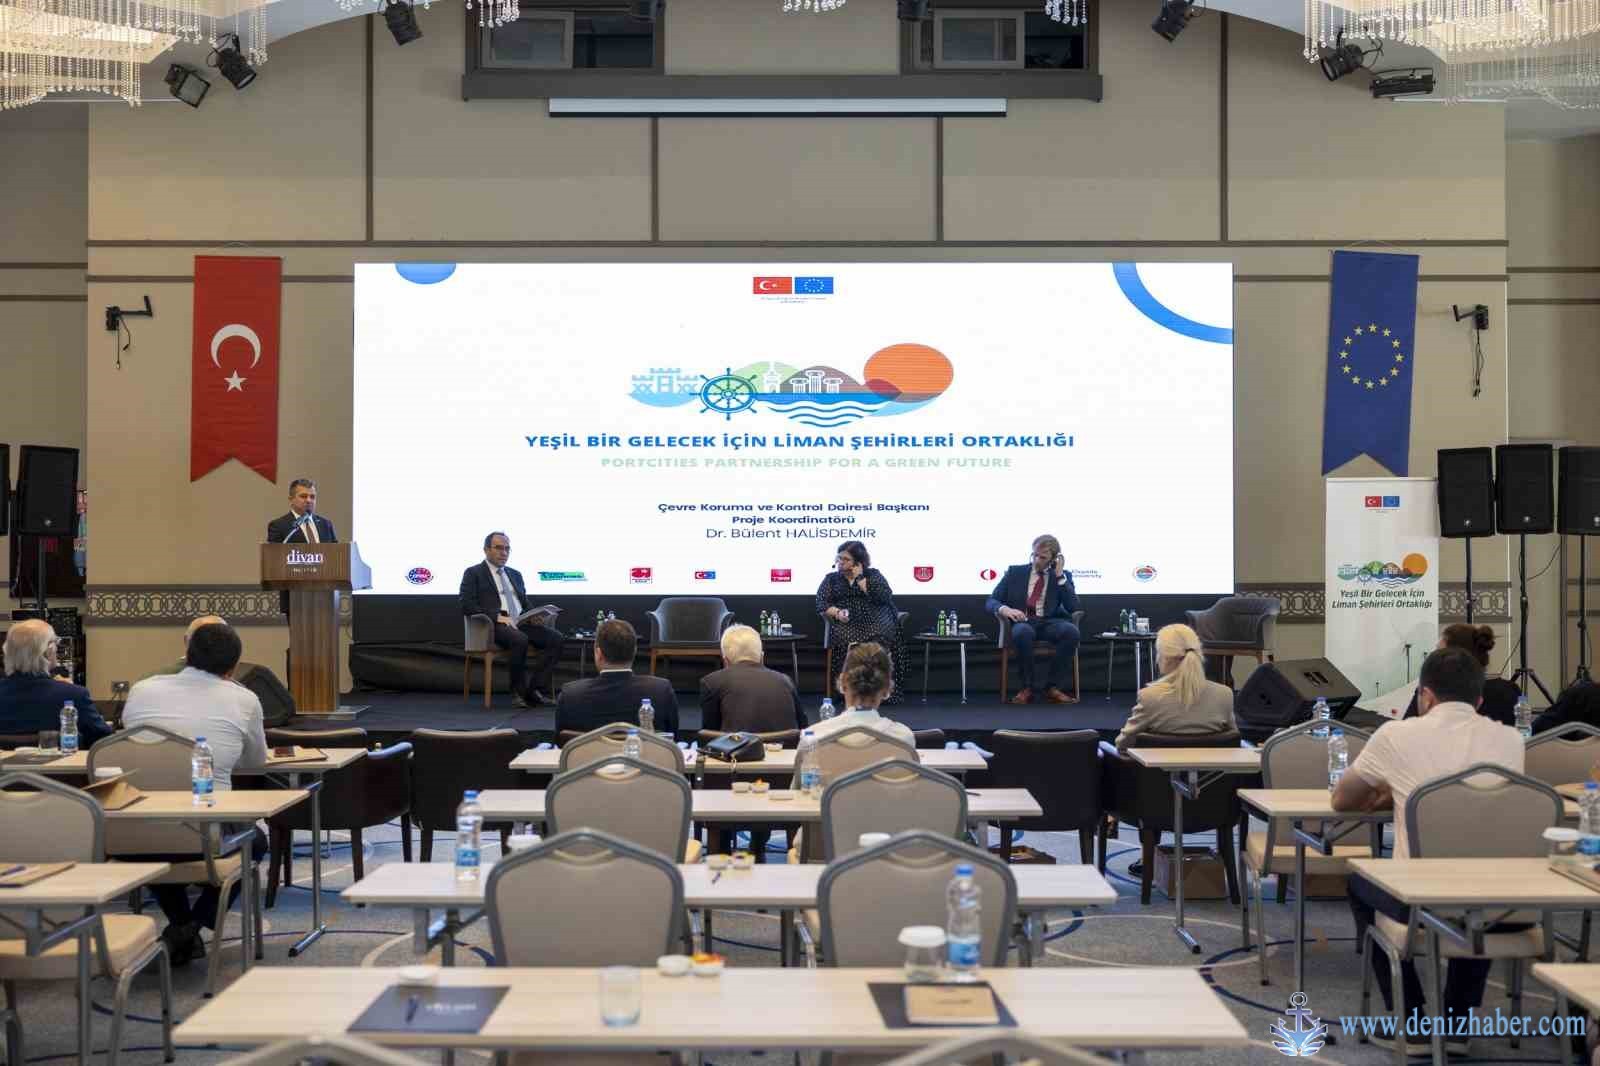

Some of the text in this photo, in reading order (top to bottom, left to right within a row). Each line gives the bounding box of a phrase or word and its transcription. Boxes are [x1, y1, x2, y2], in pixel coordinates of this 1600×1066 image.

[525, 432, 1074, 451] YEŞİL BİR GELECEK İÇİN LİMAN ŞEHİRLERİ ORTAKLIĞI
[601, 457, 1011, 468] PORTCITIES PARTNERSHIP FOR A GREEN FUTURE
[658, 502, 930, 514] Çevre Koruma ve Kontrol Dairesi Başkanı
[732, 515, 856, 525] Proje Koordinatörü
[706, 527, 876, 539] Dr. Bülent HALİSDEMİR
[287, 549, 323, 563] divan
[1360, 588, 1373, 598] Bir
[1375, 588, 1407, 598] Gelecek
[1332, 600, 1357, 609] Liman
